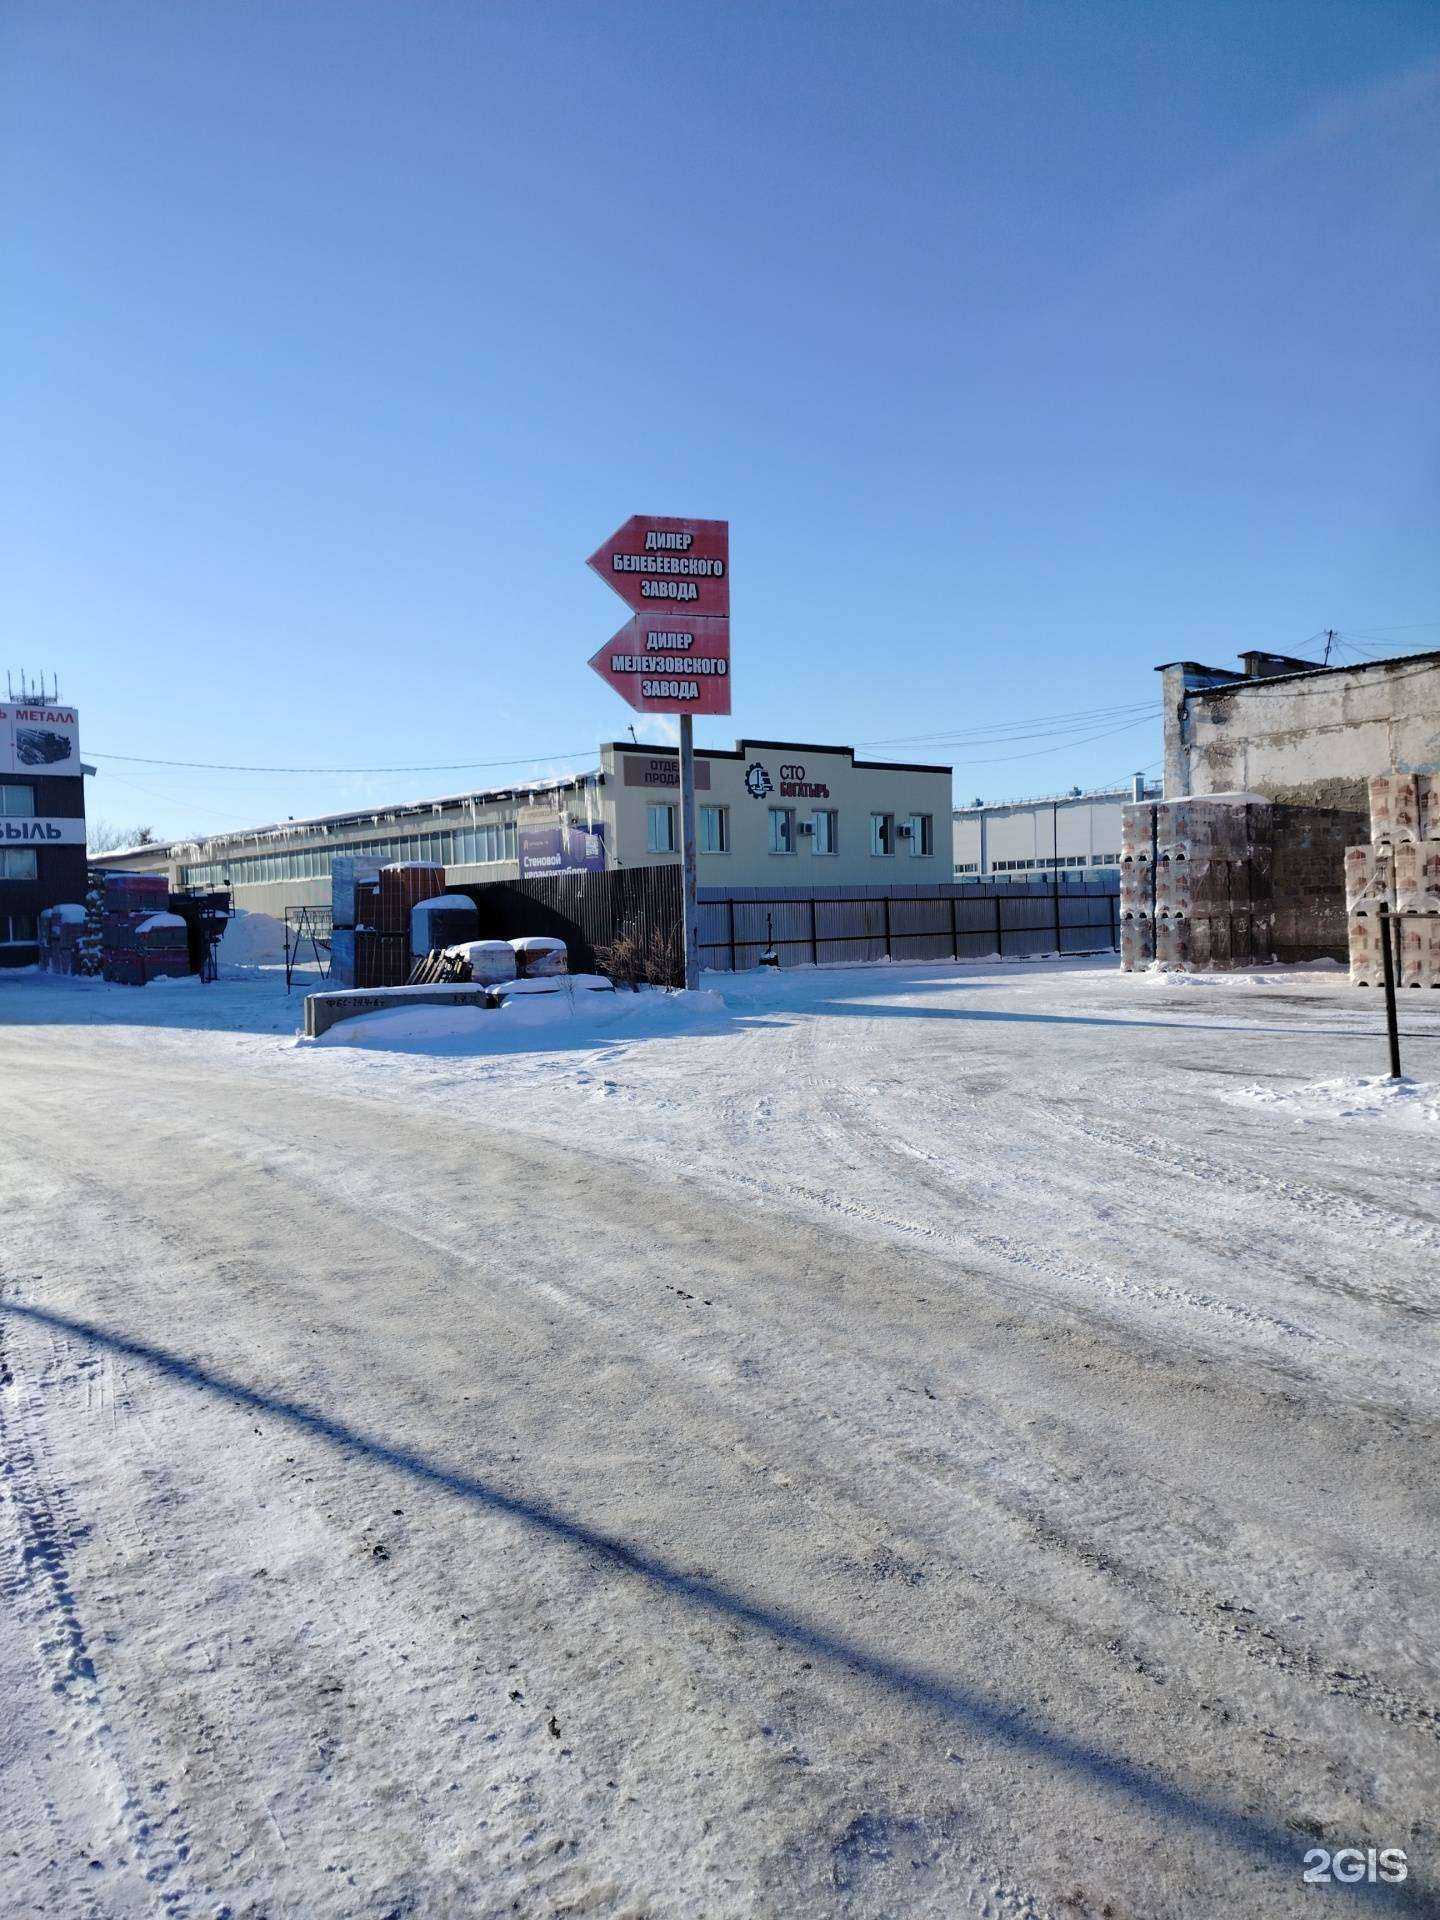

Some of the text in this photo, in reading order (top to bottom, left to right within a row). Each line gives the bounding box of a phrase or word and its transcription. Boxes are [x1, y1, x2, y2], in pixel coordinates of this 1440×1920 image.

[645, 531, 692, 550] ДИЛЕР
[613, 554, 723, 576] БЕЛЕБЕЕВСКОГО
[641, 580, 698, 600] ЗАВОДА
[647, 632, 693, 650] ДИЛЕР
[612, 655, 726, 675] МЕЛЕУЗОВСКОГО
[642, 680, 699, 699] ЗАВОДА
[16, 710, 74, 723] МЕТАЛЛ
[650, 760, 680, 773] ОТДЕ
[780, 764, 805, 780] СТО
[0, 823, 61, 839] ЫЛЬ
[524, 853, 561, 867] Стеновой
